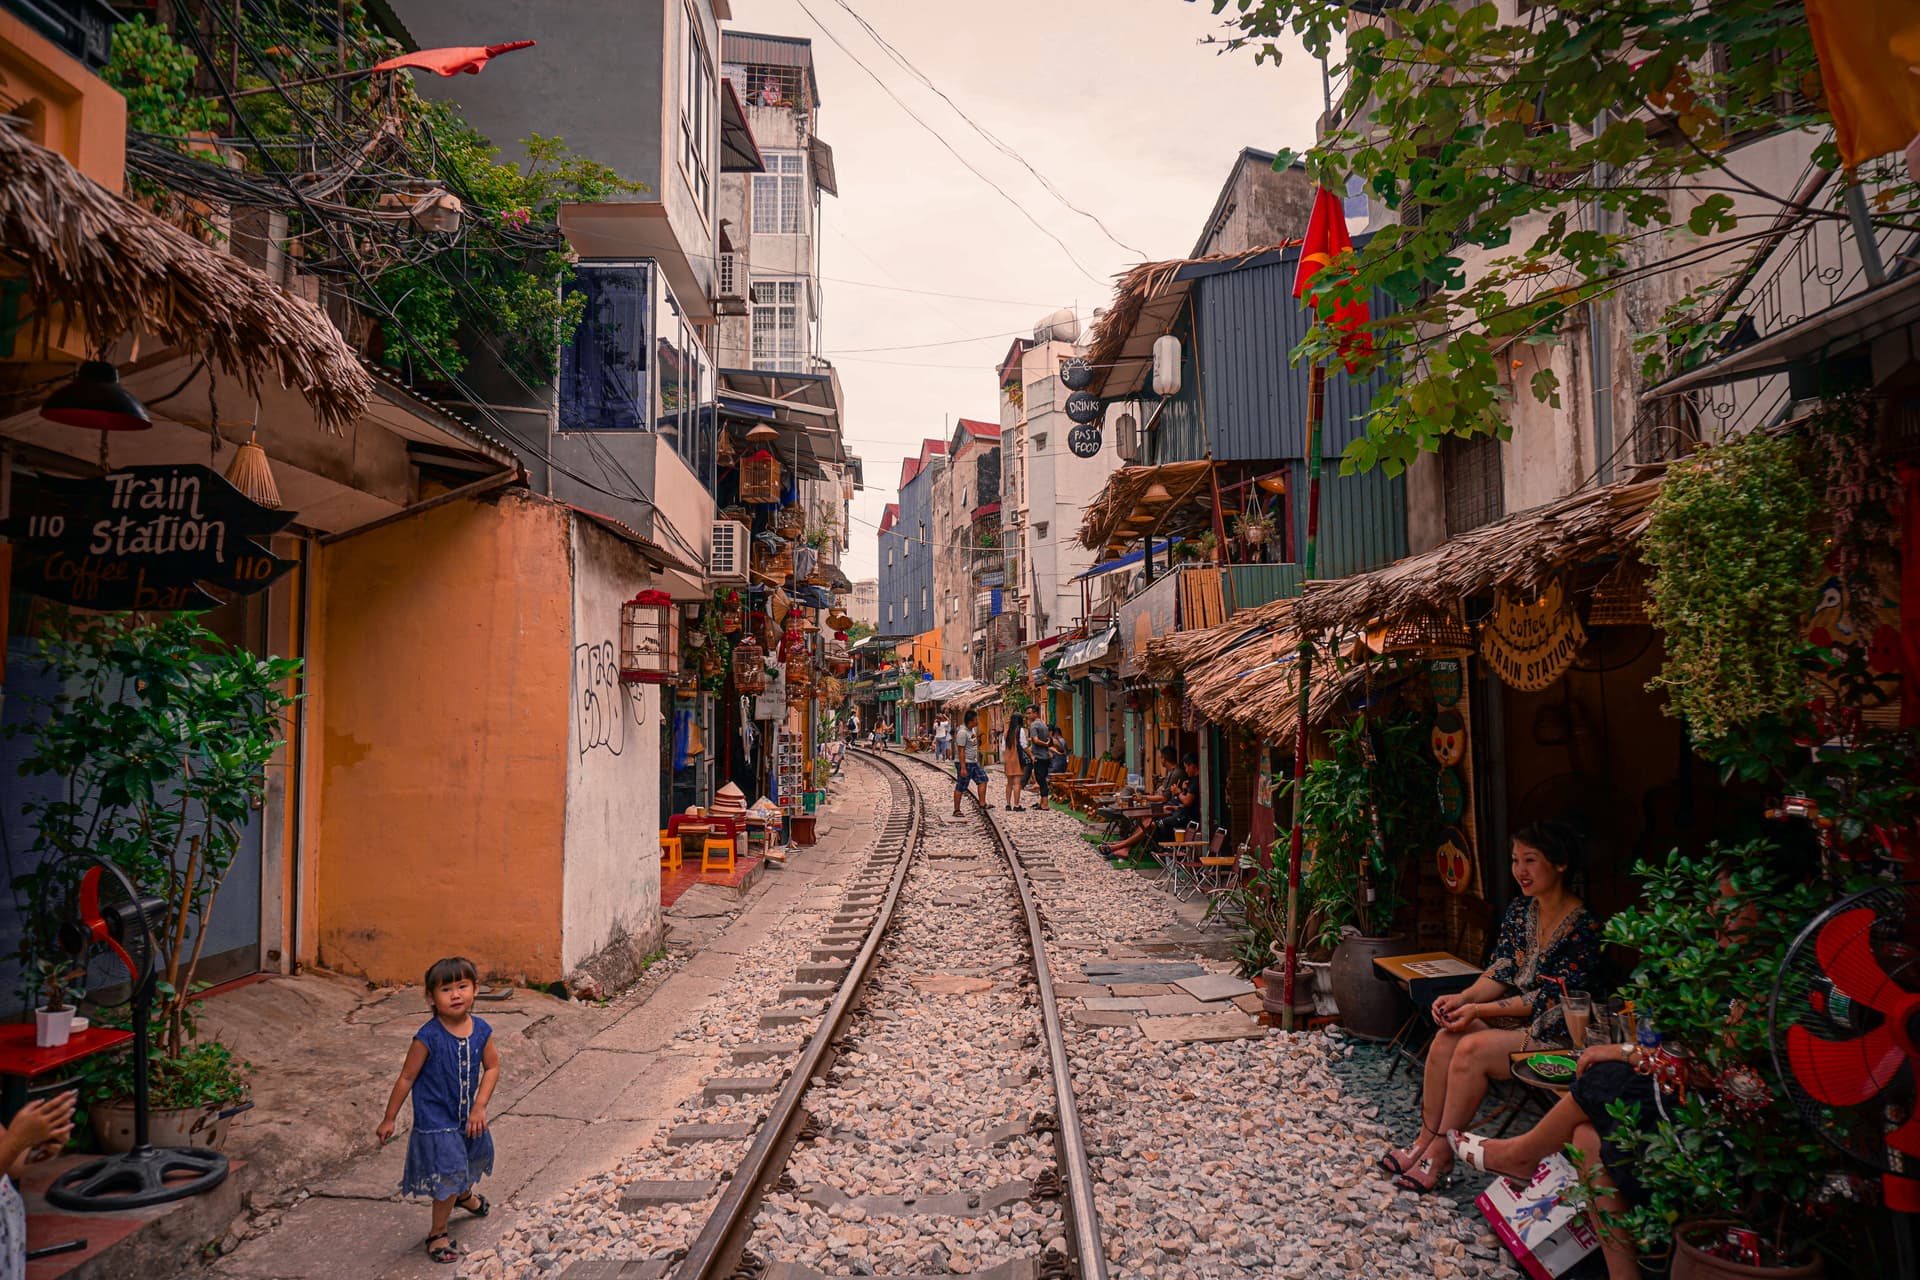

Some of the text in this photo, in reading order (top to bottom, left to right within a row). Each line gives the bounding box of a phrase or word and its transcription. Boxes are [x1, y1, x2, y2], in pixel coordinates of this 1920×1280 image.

[1069, 400, 1099, 413] DRINKS
[1074, 429, 1096, 441] FAST
[1075, 442, 1099, 454] FOOD
[105, 469, 204, 519] Train
[28, 515, 65, 538] 110
[43, 551, 128, 599] Coffee
[234, 555, 273, 581] 110
[134, 567, 191, 609] bar
[1510, 614, 1546, 637] Coffee
[1490, 629, 1576, 682] TRAIN STATION
